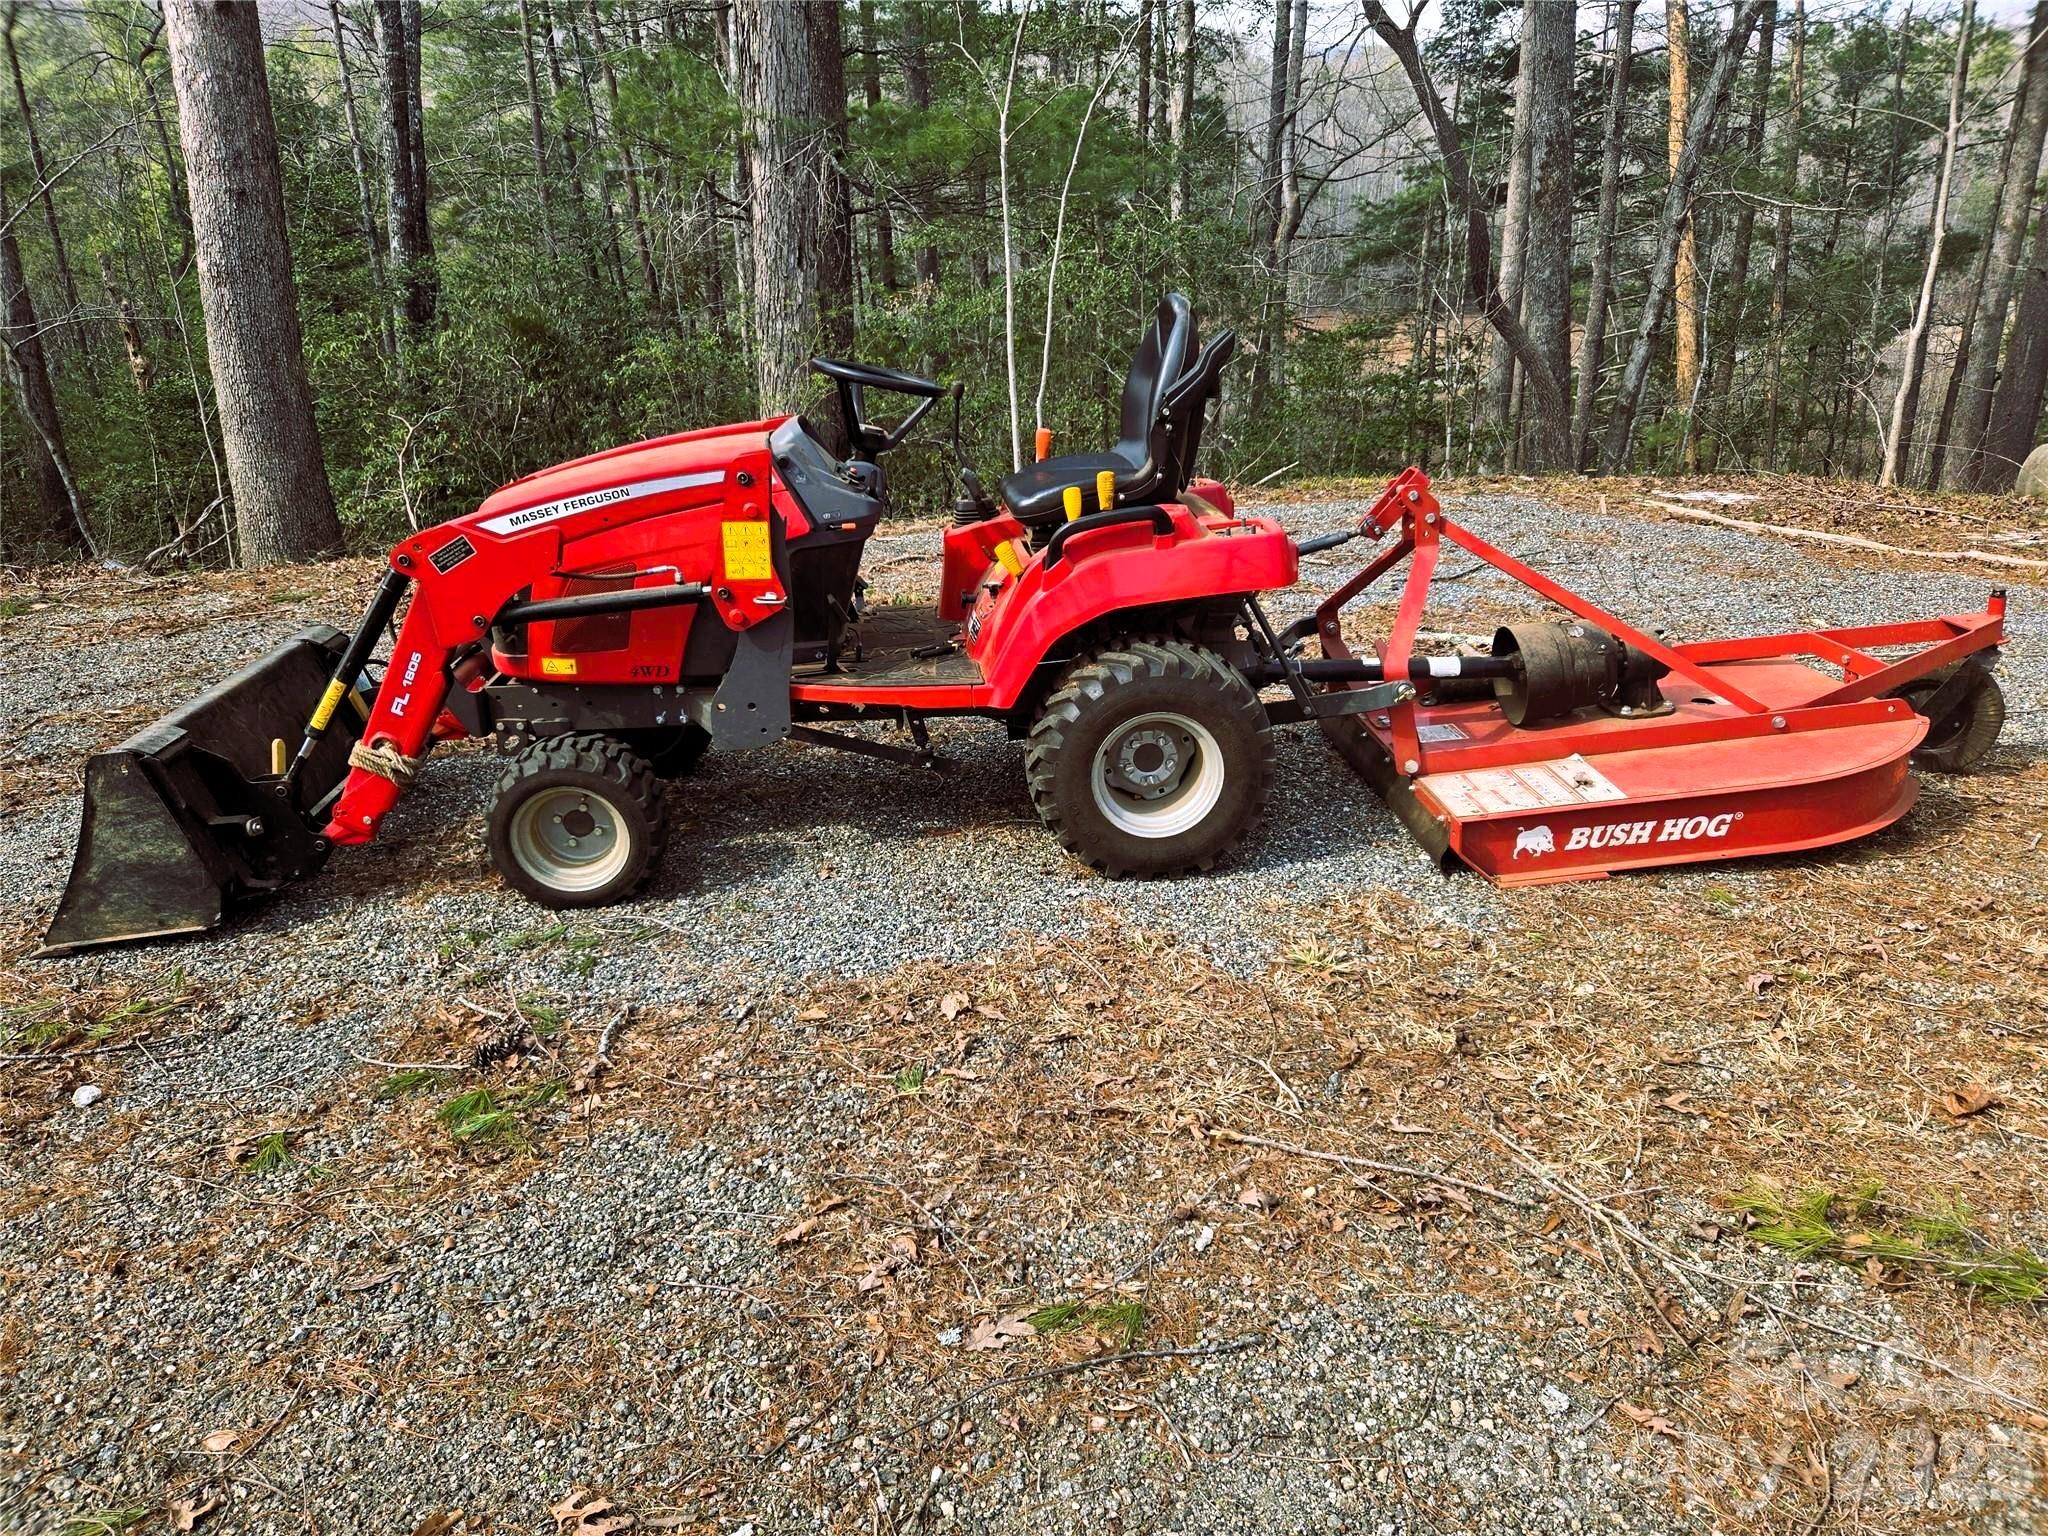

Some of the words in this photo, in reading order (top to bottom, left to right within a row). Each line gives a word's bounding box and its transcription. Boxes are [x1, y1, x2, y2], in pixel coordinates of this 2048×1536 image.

[509, 504, 560, 527] MASSEY
[564, 487, 631, 512] FERGUSON
[390, 692, 411, 717] FL
[402, 651, 422, 688] 1805
[1564, 820, 1658, 851] BUSH
